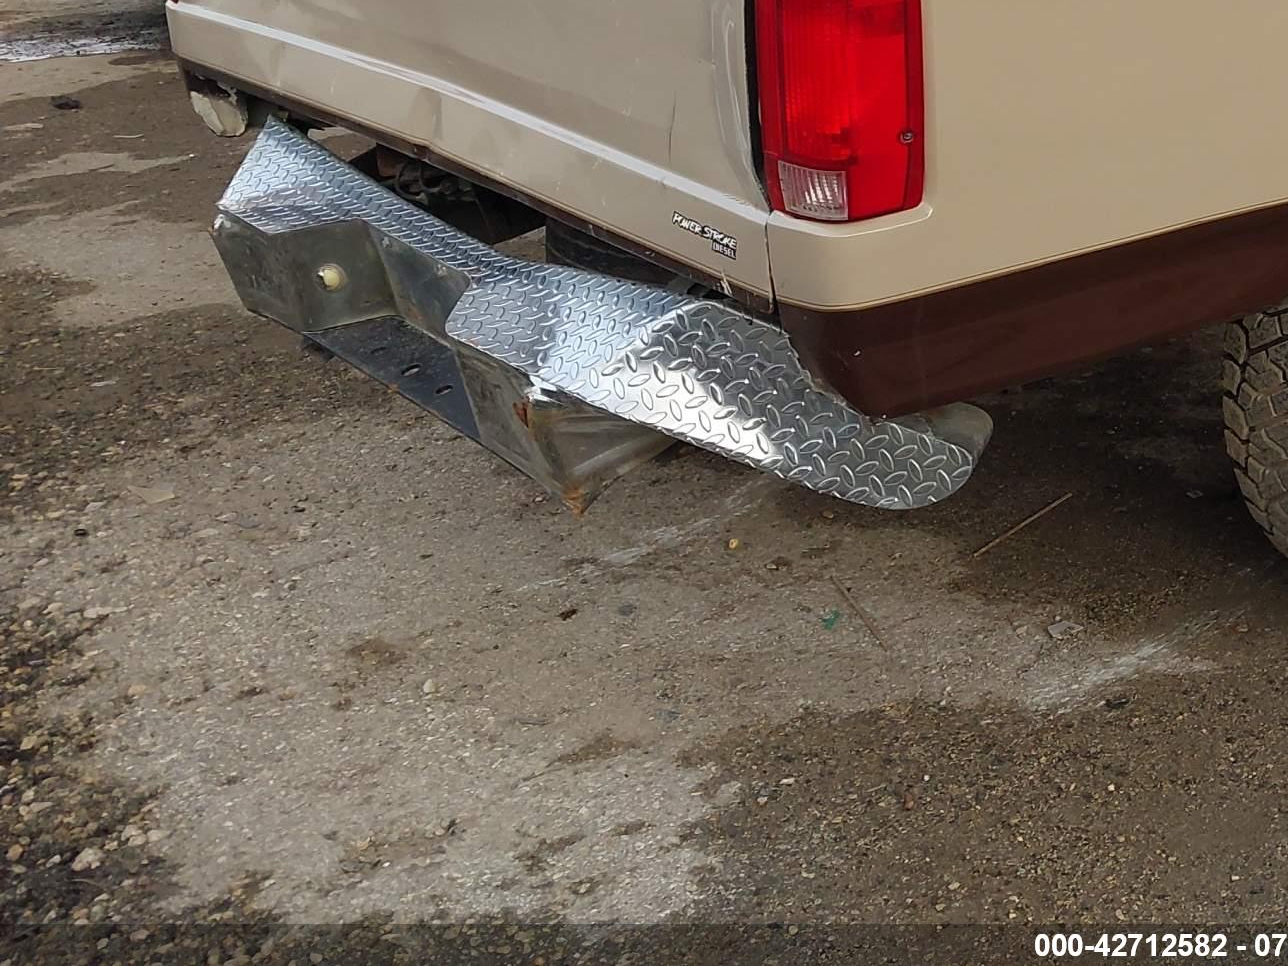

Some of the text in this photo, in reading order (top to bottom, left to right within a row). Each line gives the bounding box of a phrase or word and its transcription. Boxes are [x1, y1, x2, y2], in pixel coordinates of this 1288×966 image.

[672, 211, 737, 250] POWER STROKE
[712, 241, 737, 259] DIESEL
